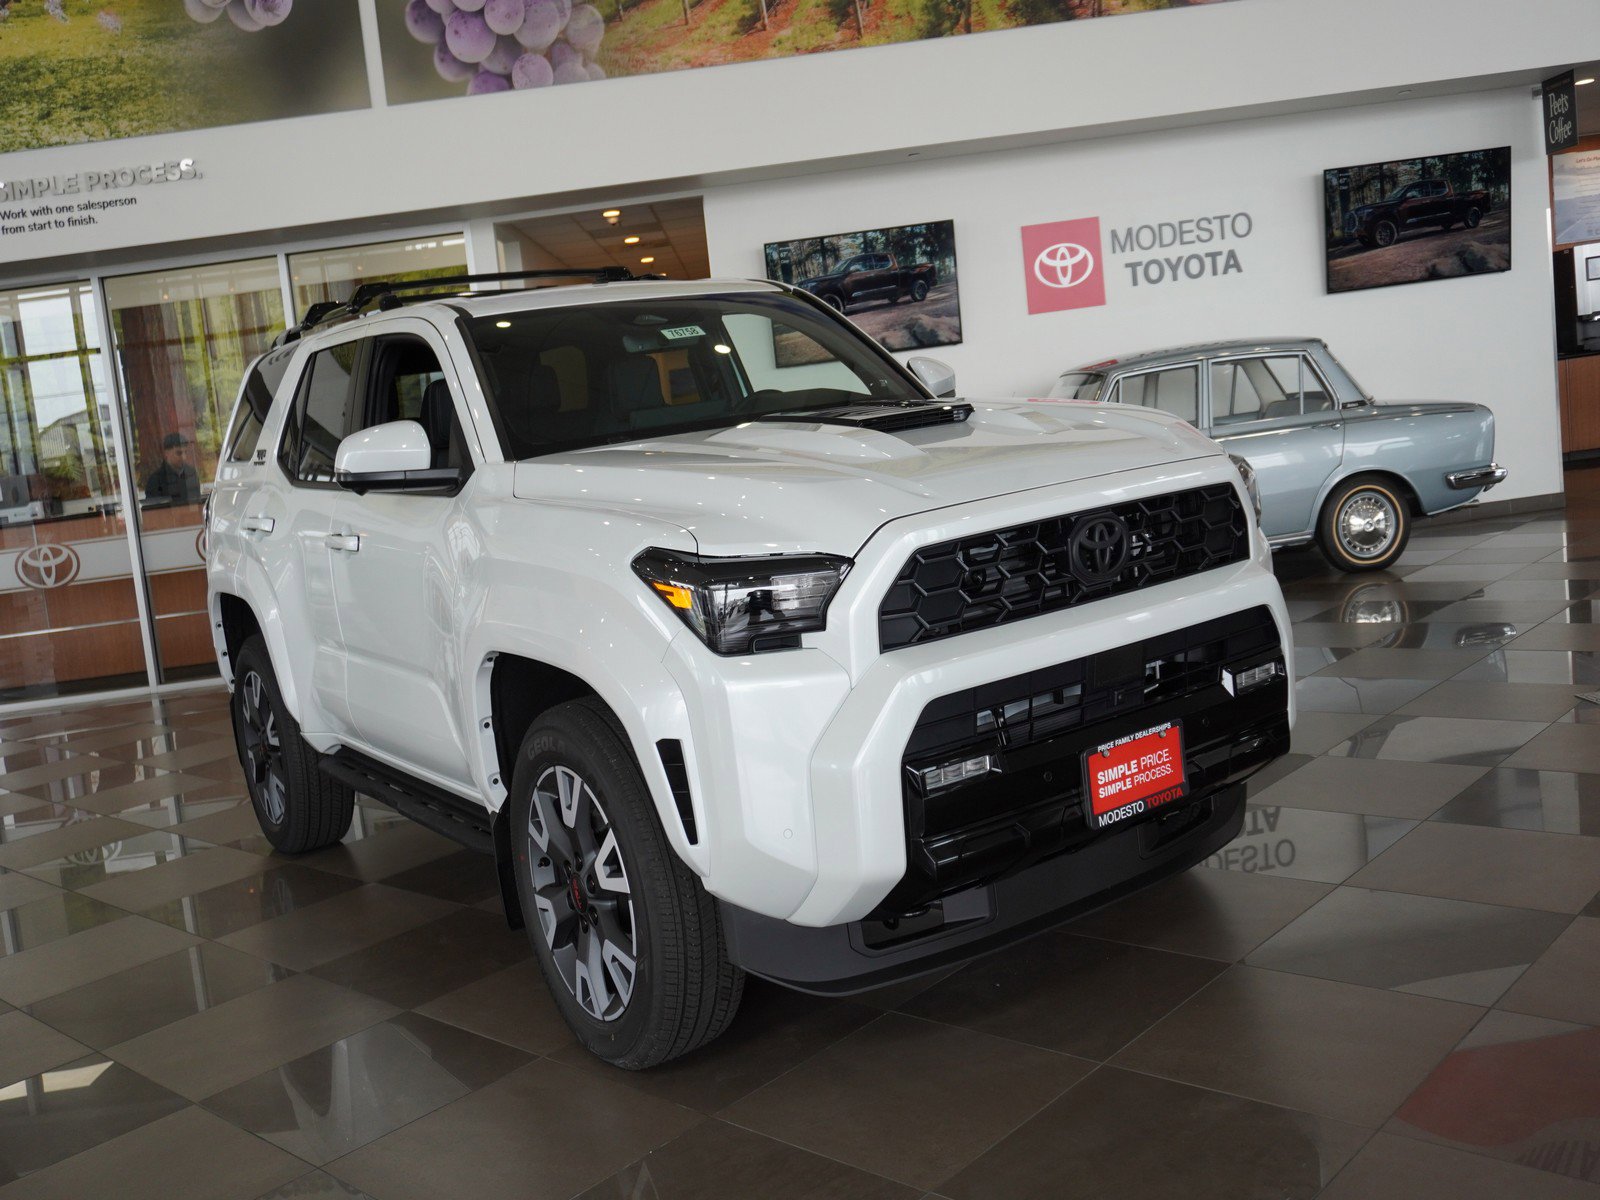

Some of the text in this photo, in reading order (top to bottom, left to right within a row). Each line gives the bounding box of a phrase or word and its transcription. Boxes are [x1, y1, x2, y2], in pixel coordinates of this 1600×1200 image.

[1549, 116, 1573, 144] Coffee
[83, 158, 203, 192] PROCESS.
[0, 196, 137, 221] Work with one salesperson
[1, 215, 98, 235] from start to finish.
[1110, 212, 1253, 254] MODESTO
[1125, 249, 1244, 286] TOYOTA
[1097, 722, 1171, 752] PRICE FAMILY DEALERSHIPS
[1097, 749, 1172, 785] SIMPLE PRICE.
[1098, 764, 1173, 799] SIMPLE PROCESS.
[1098, 787, 1183, 827] MODESTO TOYOTA
